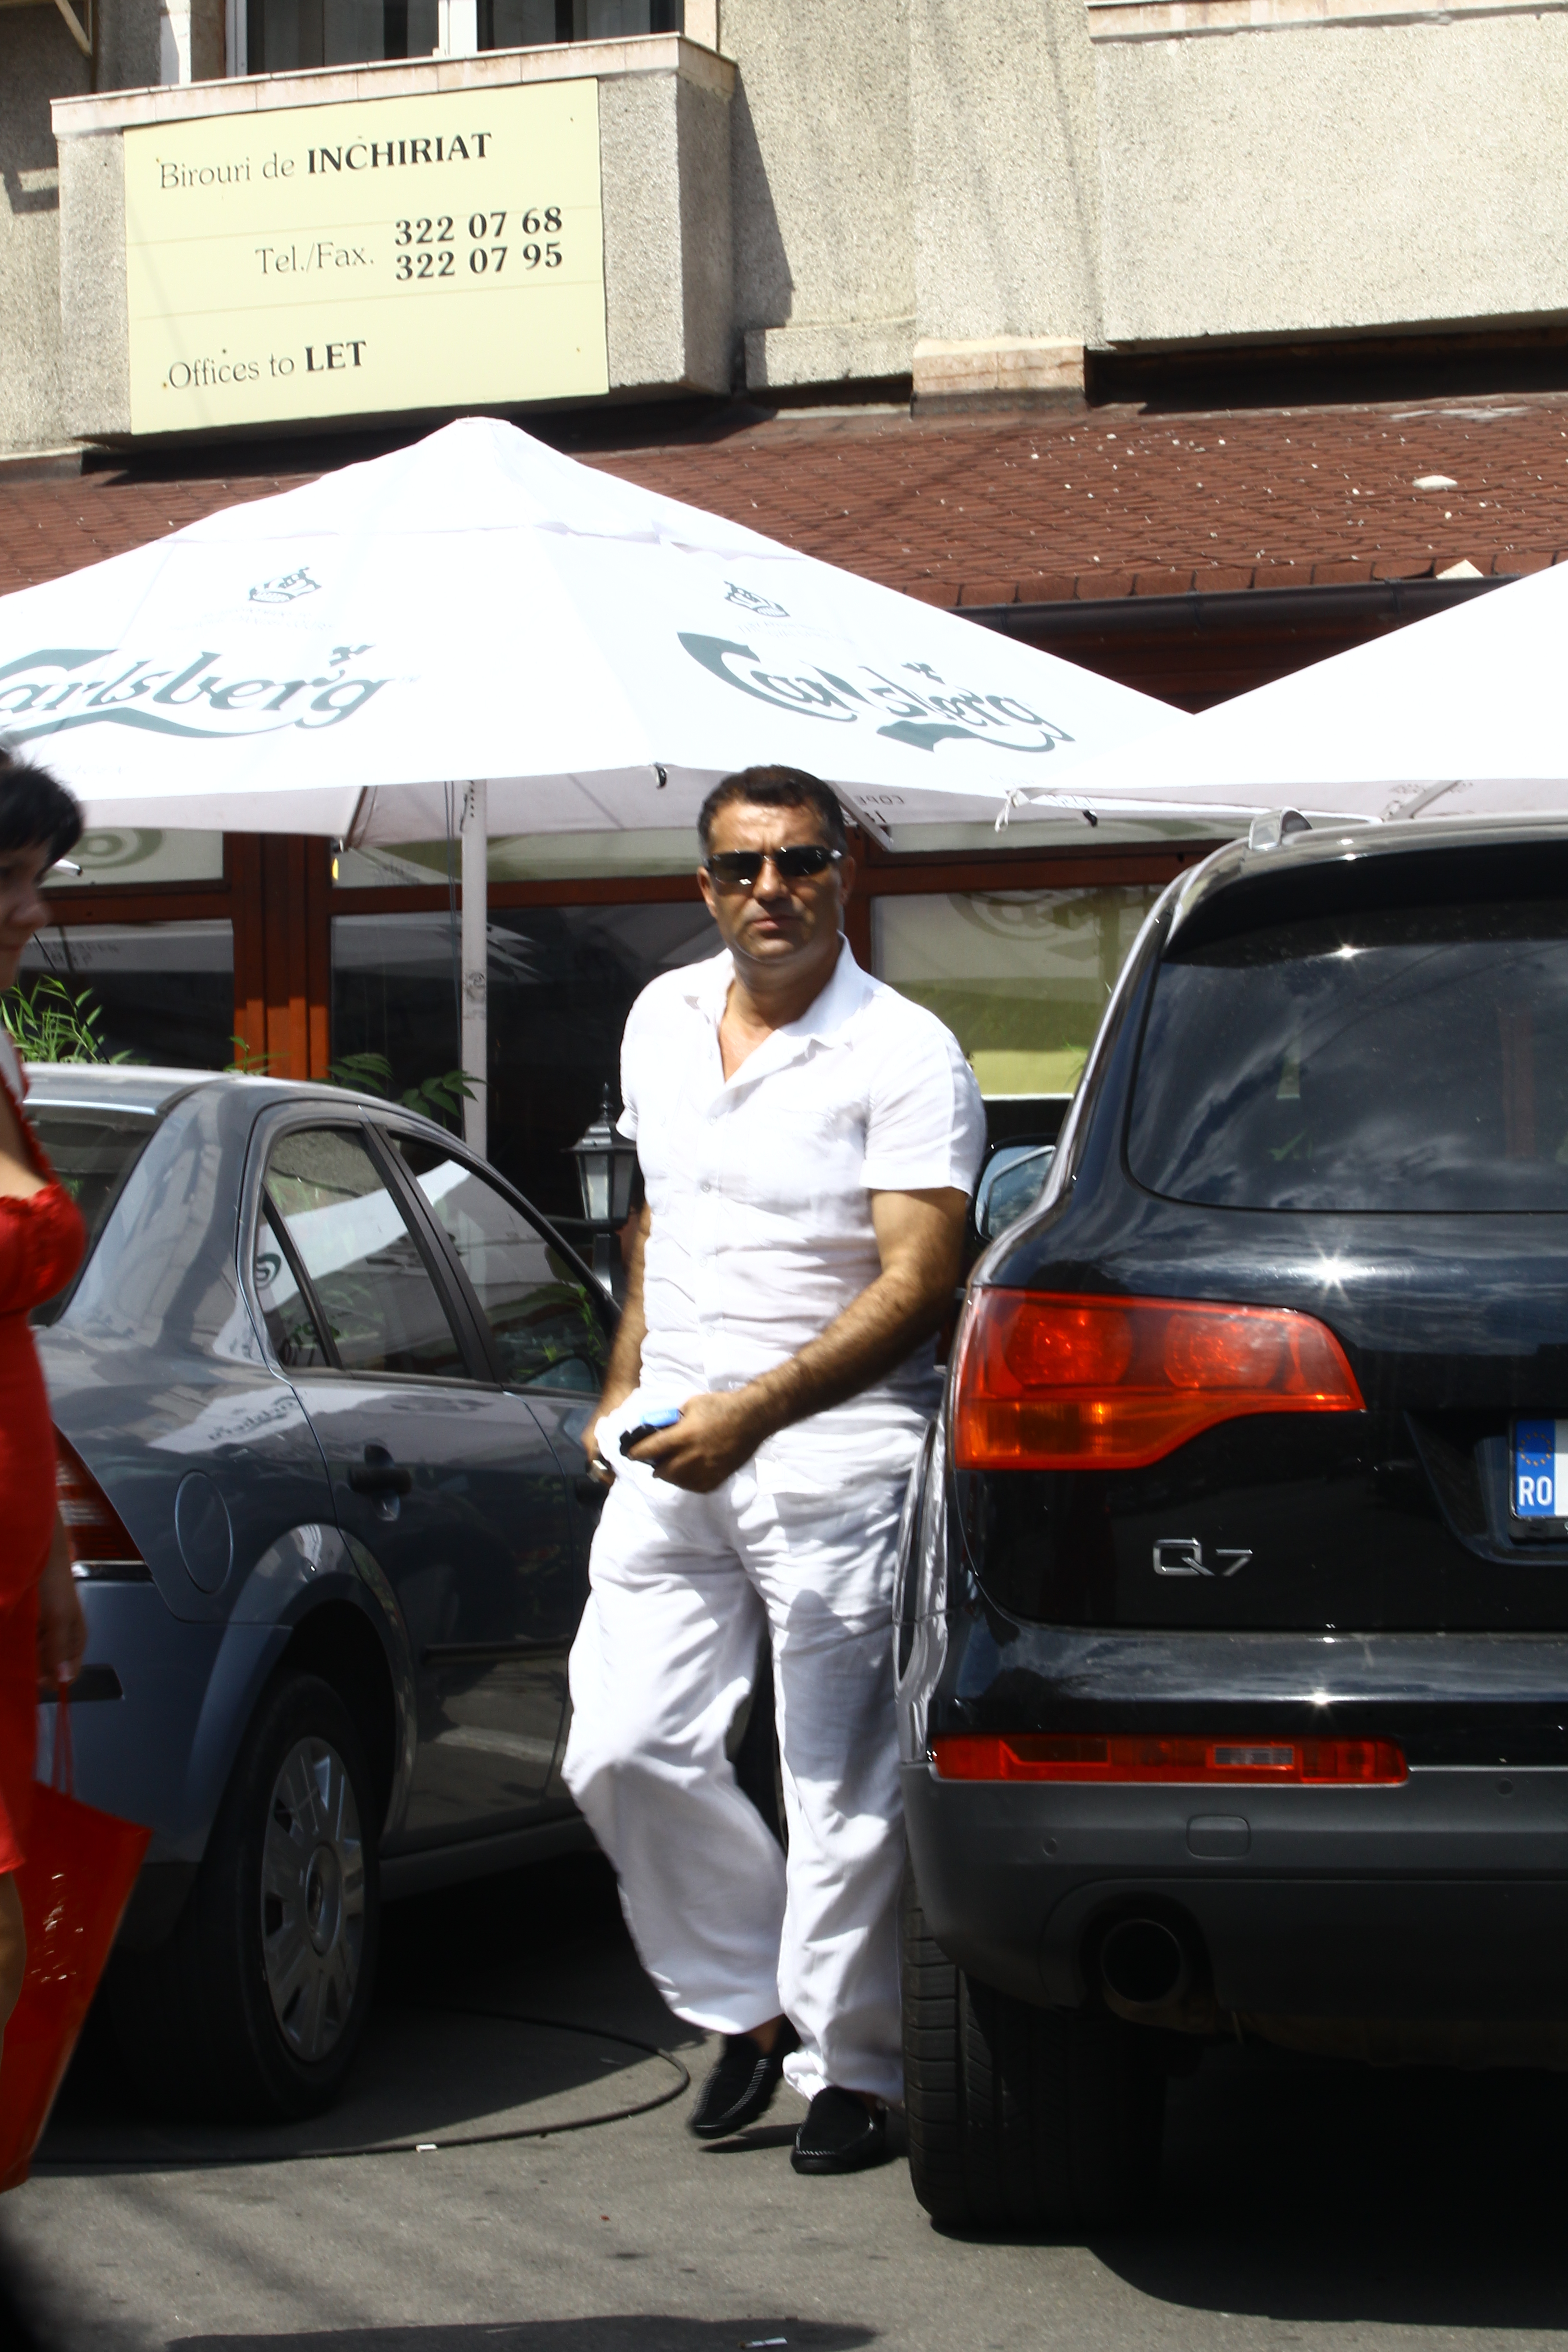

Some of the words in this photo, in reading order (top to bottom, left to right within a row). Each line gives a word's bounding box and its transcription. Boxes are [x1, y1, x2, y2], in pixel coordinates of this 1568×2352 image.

[160, 156, 251, 189] Birouri
[262, 151, 295, 180] de
[308, 132, 492, 174] INCHIRIAT
[395, 216, 455, 246] 322
[468, 211, 507, 239] 07
[522, 207, 563, 235] 68
[255, 241, 375, 274] Tel./Fax.
[396, 251, 455, 281] 322
[469, 246, 508, 274] 07
[523, 242, 563, 269] 95
[168, 357, 260, 390] Offices
[269, 353, 295, 377] to
[305, 340, 367, 372] LET
[677, 631, 1076, 753] Carlsberg
[1518, 1475, 1553, 1507] RO
[1153, 1538, 1253, 1577] Q7
